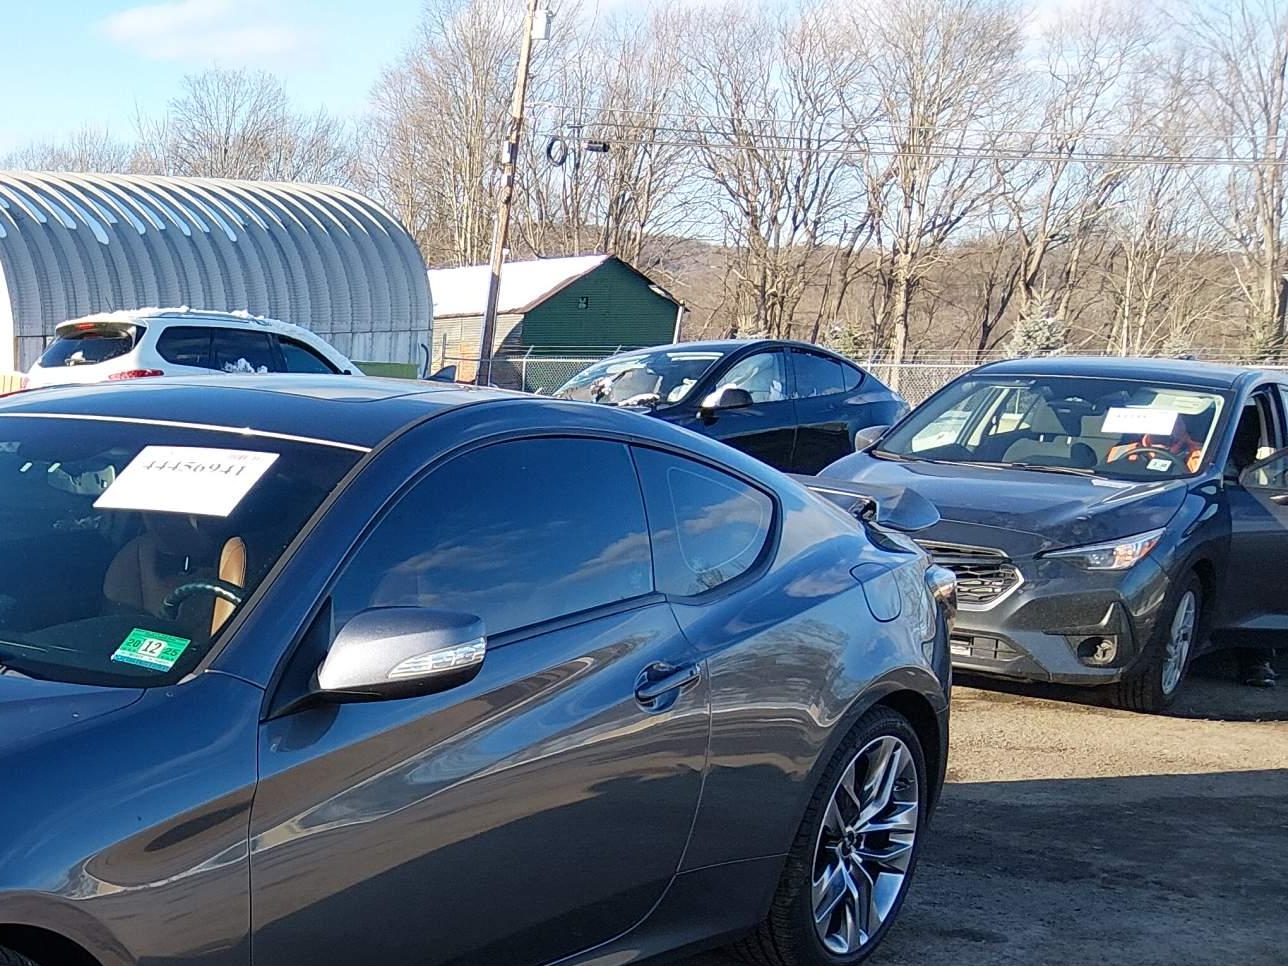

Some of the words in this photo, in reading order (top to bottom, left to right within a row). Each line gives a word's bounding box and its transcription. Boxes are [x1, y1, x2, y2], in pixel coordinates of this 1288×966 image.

[128, 639, 142, 648] 20
[141, 640, 163, 654] 12
[163, 648, 180, 656] 25
